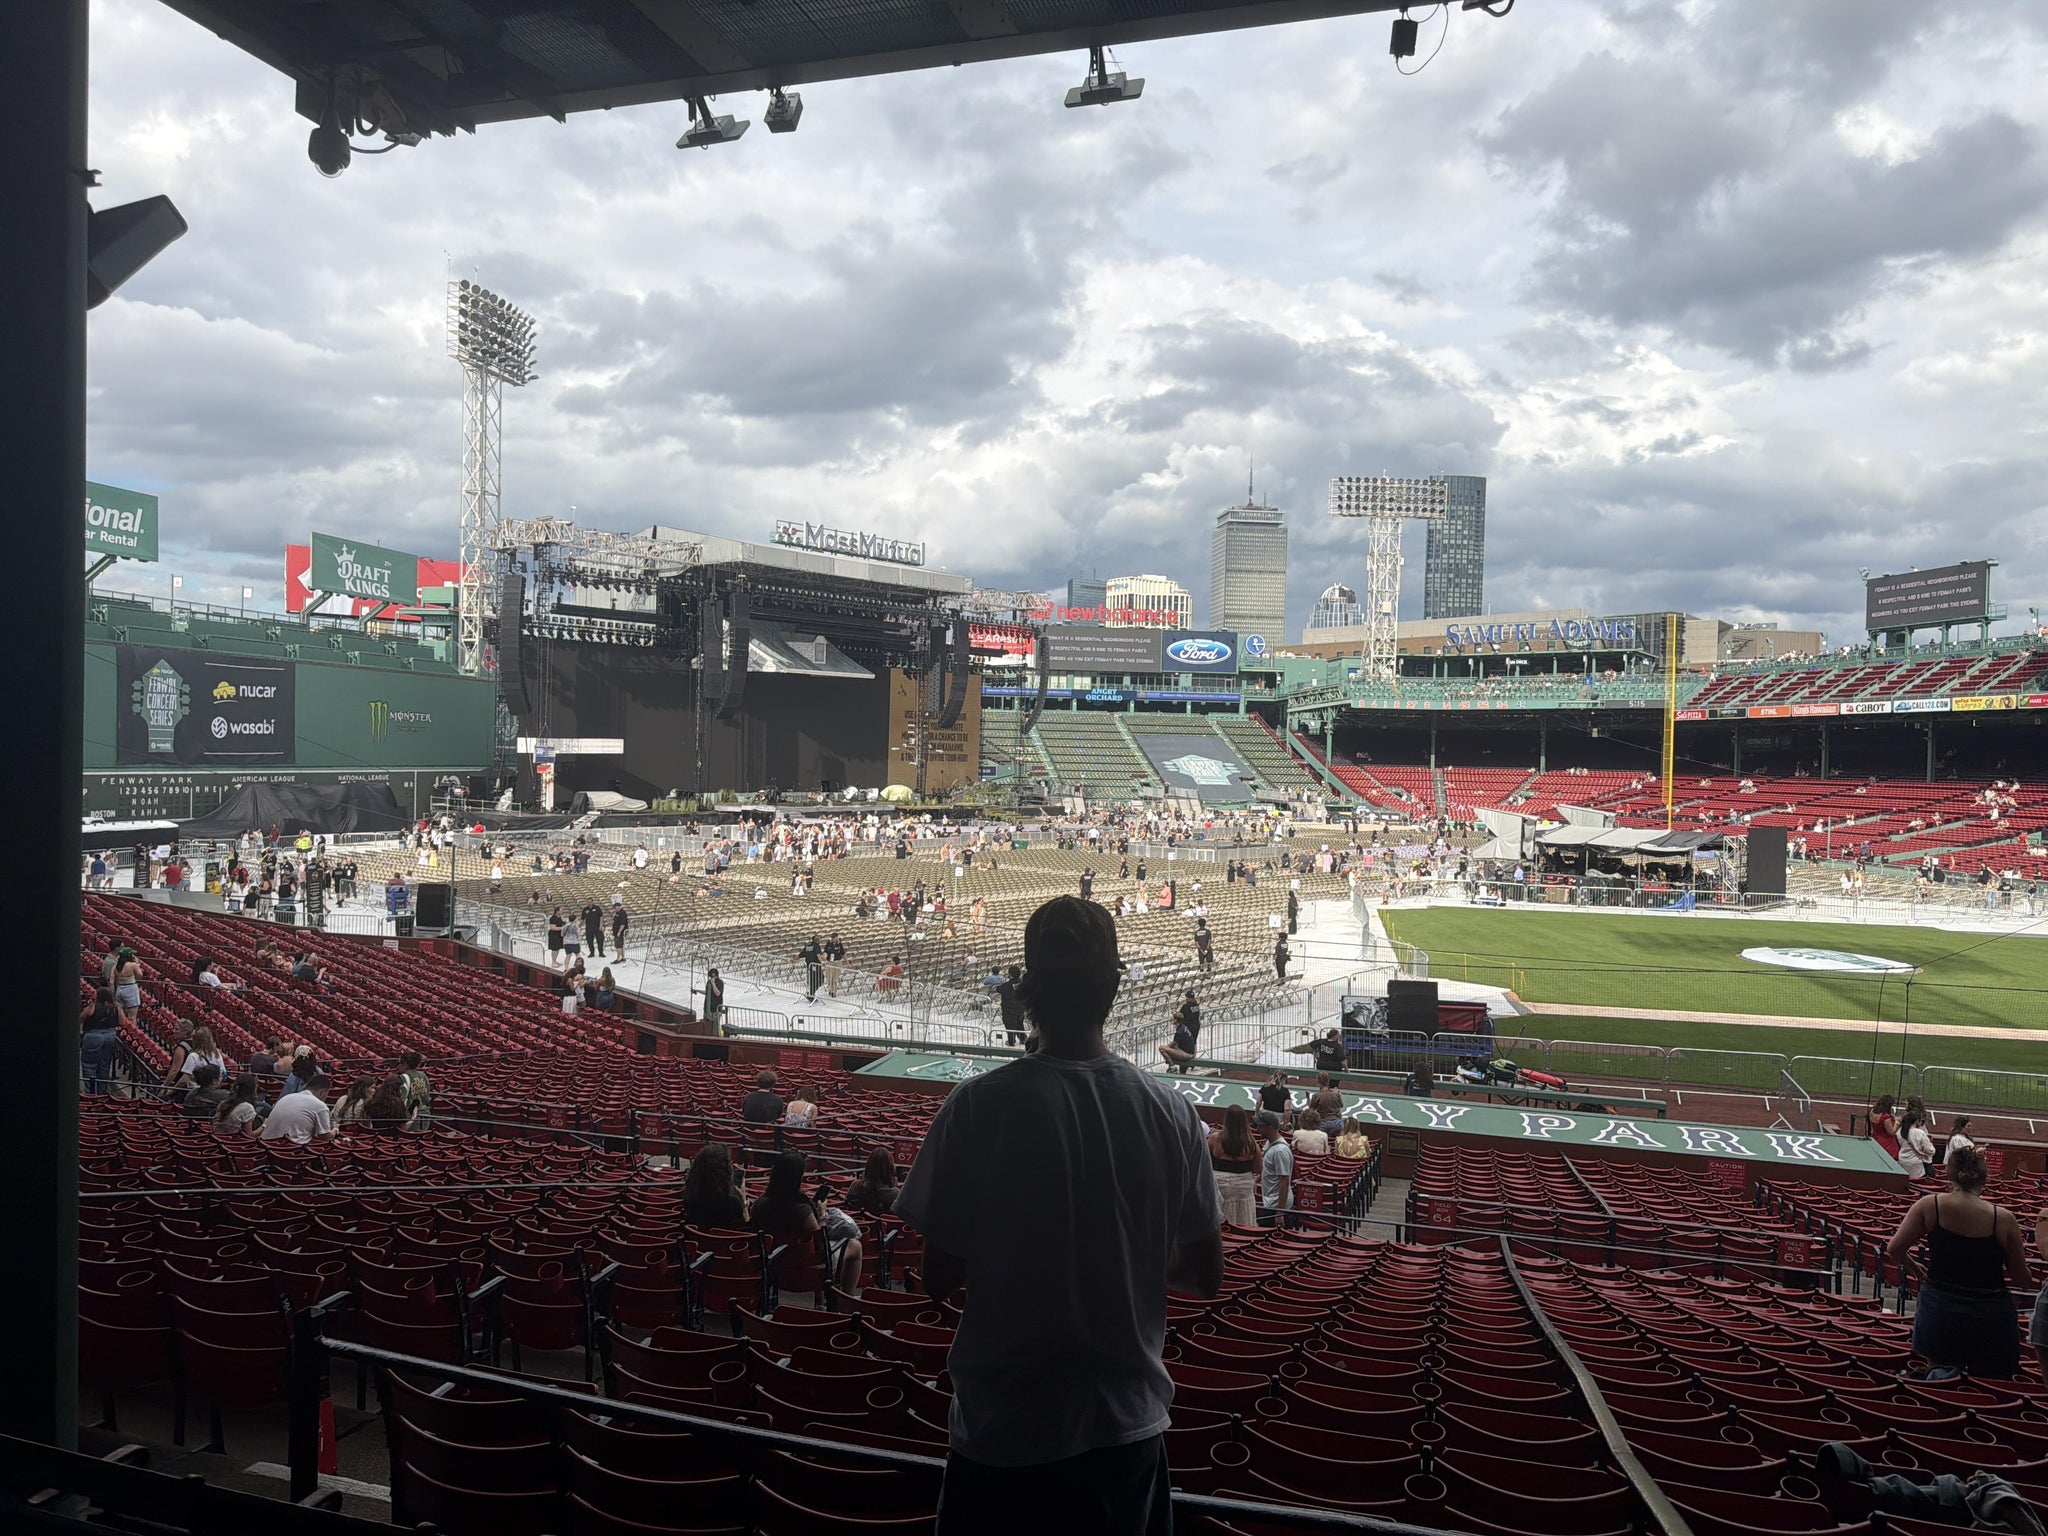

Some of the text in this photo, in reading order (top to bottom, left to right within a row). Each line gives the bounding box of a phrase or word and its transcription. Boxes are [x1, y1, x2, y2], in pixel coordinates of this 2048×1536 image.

[85, 498, 142, 533] ional
[85, 530, 138, 547] ar Rental
[803, 521, 925, 566] MassMutual
[337, 560, 391, 583] DRAFT
[345, 576, 390, 598] KINGS
[1938, 589, 1955, 597] FENWAY
[1919, 604, 1936, 612] FENWAY
[1057, 603, 1178, 625] new balance
[1446, 618, 1635, 647] SAMUEL ADAMS
[1180, 643, 1218, 660] Ford
[148, 677, 177, 694] FENWAY
[239, 684, 277, 698] nucar
[147, 694, 177, 710] CONCERT
[1911, 700, 1949, 710] CALL128.COM
[1810, 705, 1837, 713] Hawaiian
[150, 710, 173, 726] SERIES
[389, 711, 432, 723] MONSTER
[230, 719, 275, 735] wasabi
[101, 777, 152, 785] FENWAY
[147, 786, 152, 794] 5
[154, 786, 159, 794] 6
[168, 786, 173, 794] 8
[175, 786, 180, 794] 9
[131, 798, 159, 806] NOAH
[90, 810, 116, 818] BOSTON
[131, 808, 167, 816] KAHAN
[644, 1127, 658, 1135] 68
[1519, 1112, 1844, 1163] PARK
[898, 1152, 912, 1161] 67
[1709, 1162, 1745, 1170] CAUTION!
[1300, 1199, 1318, 1208] 65
[1432, 1213, 1451, 1223] 64
[1783, 1253, 1805, 1263] 63
